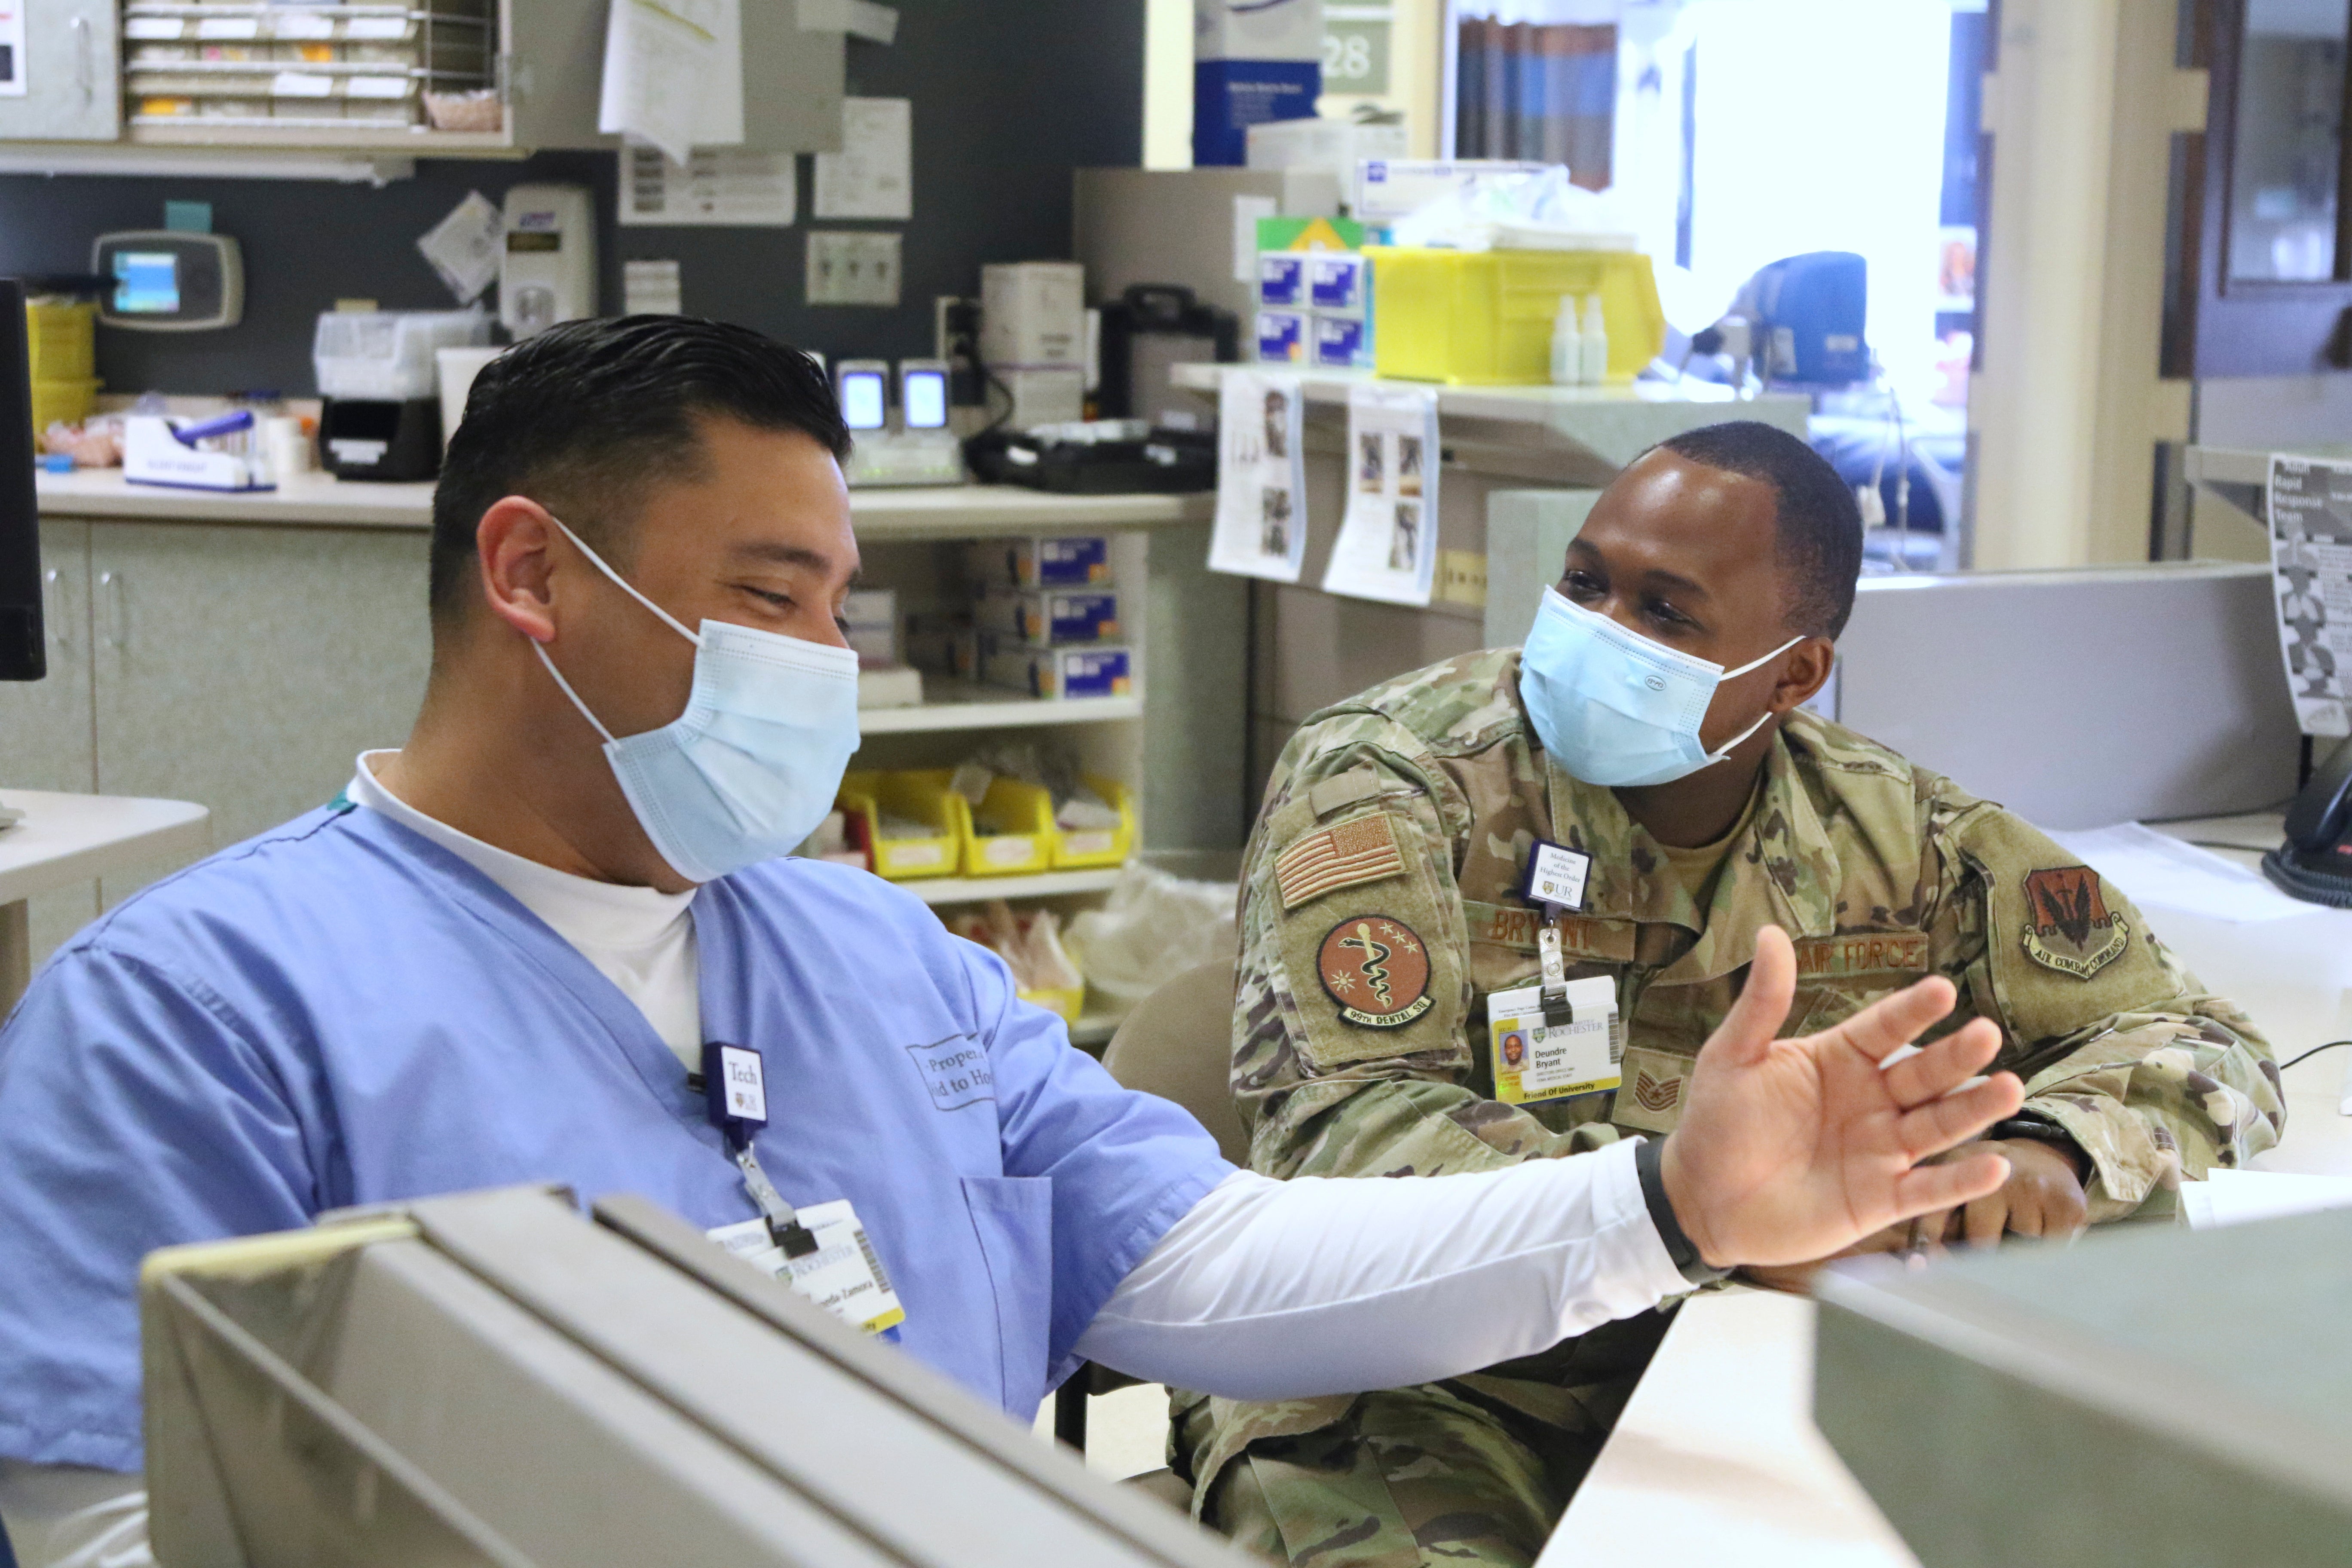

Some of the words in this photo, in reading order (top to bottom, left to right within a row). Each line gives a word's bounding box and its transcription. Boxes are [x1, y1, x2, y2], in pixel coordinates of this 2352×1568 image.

[1320, 34, 1370, 78] 28
[2275, 475, 2303, 491] Rapid
[2275, 491, 2323, 508] Response
[2275, 508, 2303, 521] Team
[1550, 852, 1576, 864] Medicine
[1540, 867, 1562, 878] Highest
[1564, 873, 1580, 882] Order
[1555, 884, 1572, 897] UR
[1492, 910, 1596, 949] BRYNT
[1797, 943, 1834, 974] AIR
[1844, 940, 1919, 971] FORCE
[2034, 949, 2052, 963] AIR
[2055, 957, 2090, 976] COMBAT
[2090, 937, 2125, 969] COMMAND
[1350, 1011, 1372, 1024] 99TH
[1376, 1011, 1412, 1024] DENTAL
[1413, 1001, 1428, 1012] SQ
[1548, 1022, 1603, 1038] ROCHESTER
[1535, 1047, 1567, 1059] Deundre
[1536, 1058, 1561, 1069] Bryant
[728, 1061, 758, 1085] Tech
[949, 1078, 969, 1093] to
[1524, 1091, 1547, 1099] Friend
[1559, 1082, 1595, 1095] University
